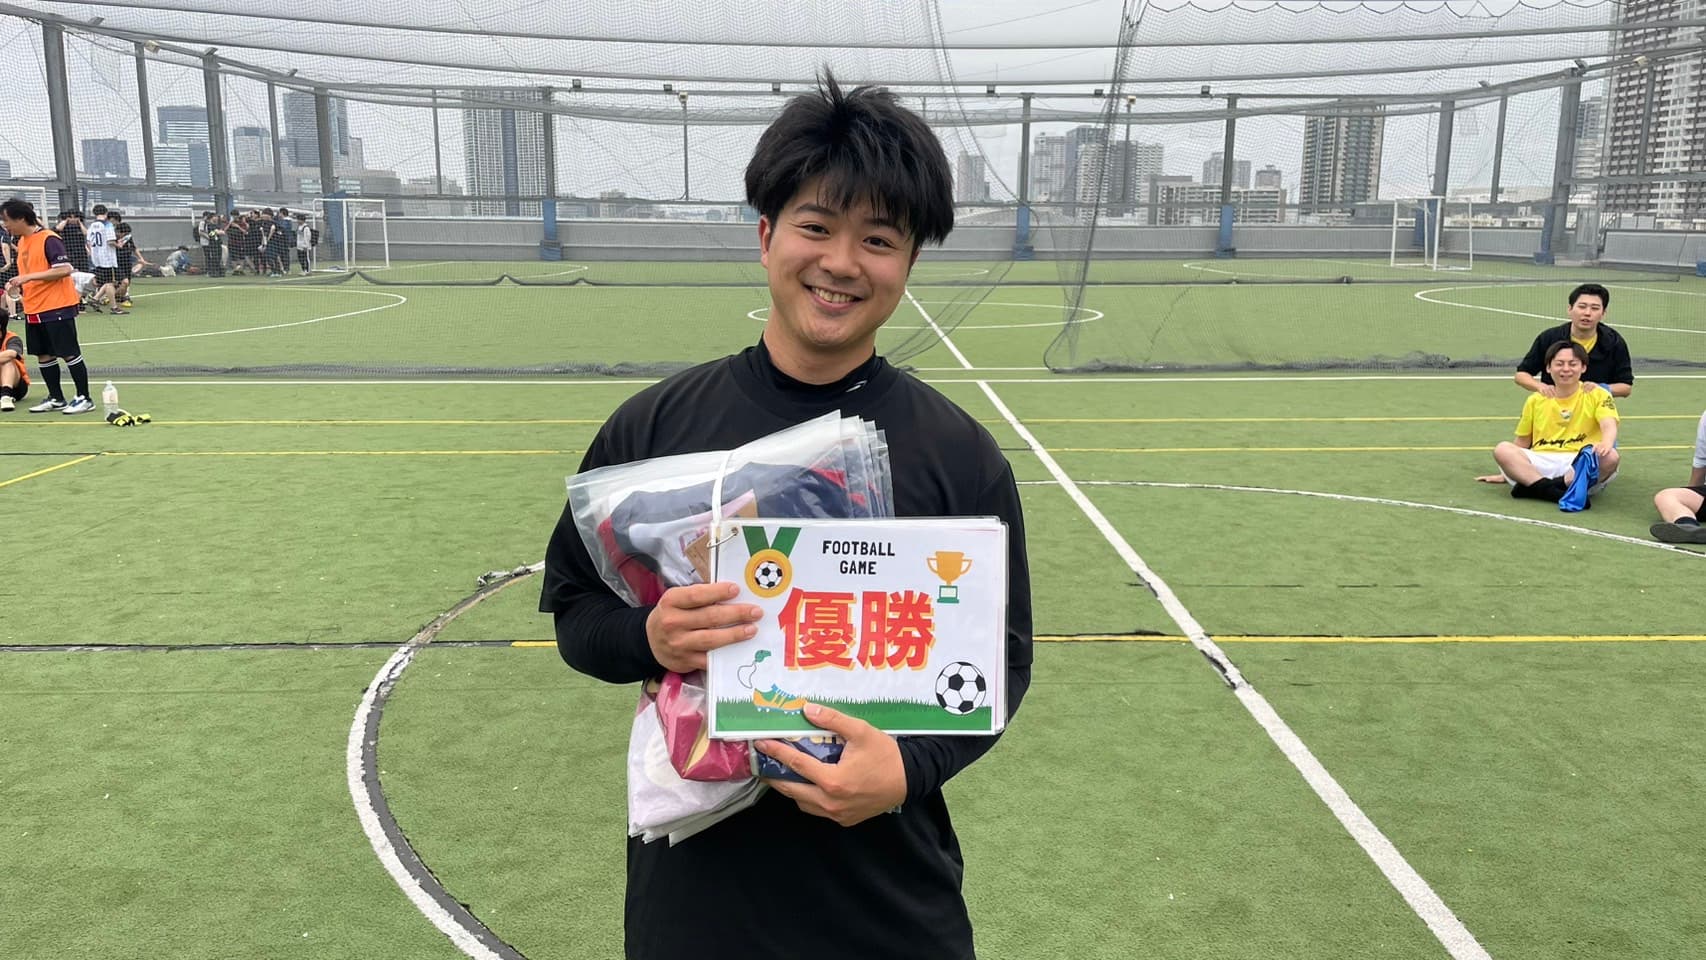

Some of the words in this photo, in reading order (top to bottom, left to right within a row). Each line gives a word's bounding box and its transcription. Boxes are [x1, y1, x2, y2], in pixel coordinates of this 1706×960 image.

[90, 231, 102, 247] 20
[822, 540, 896, 557] FOOTBALL
[839, 560, 877, 575] GAME
[778, 587, 936, 671] 優勝
